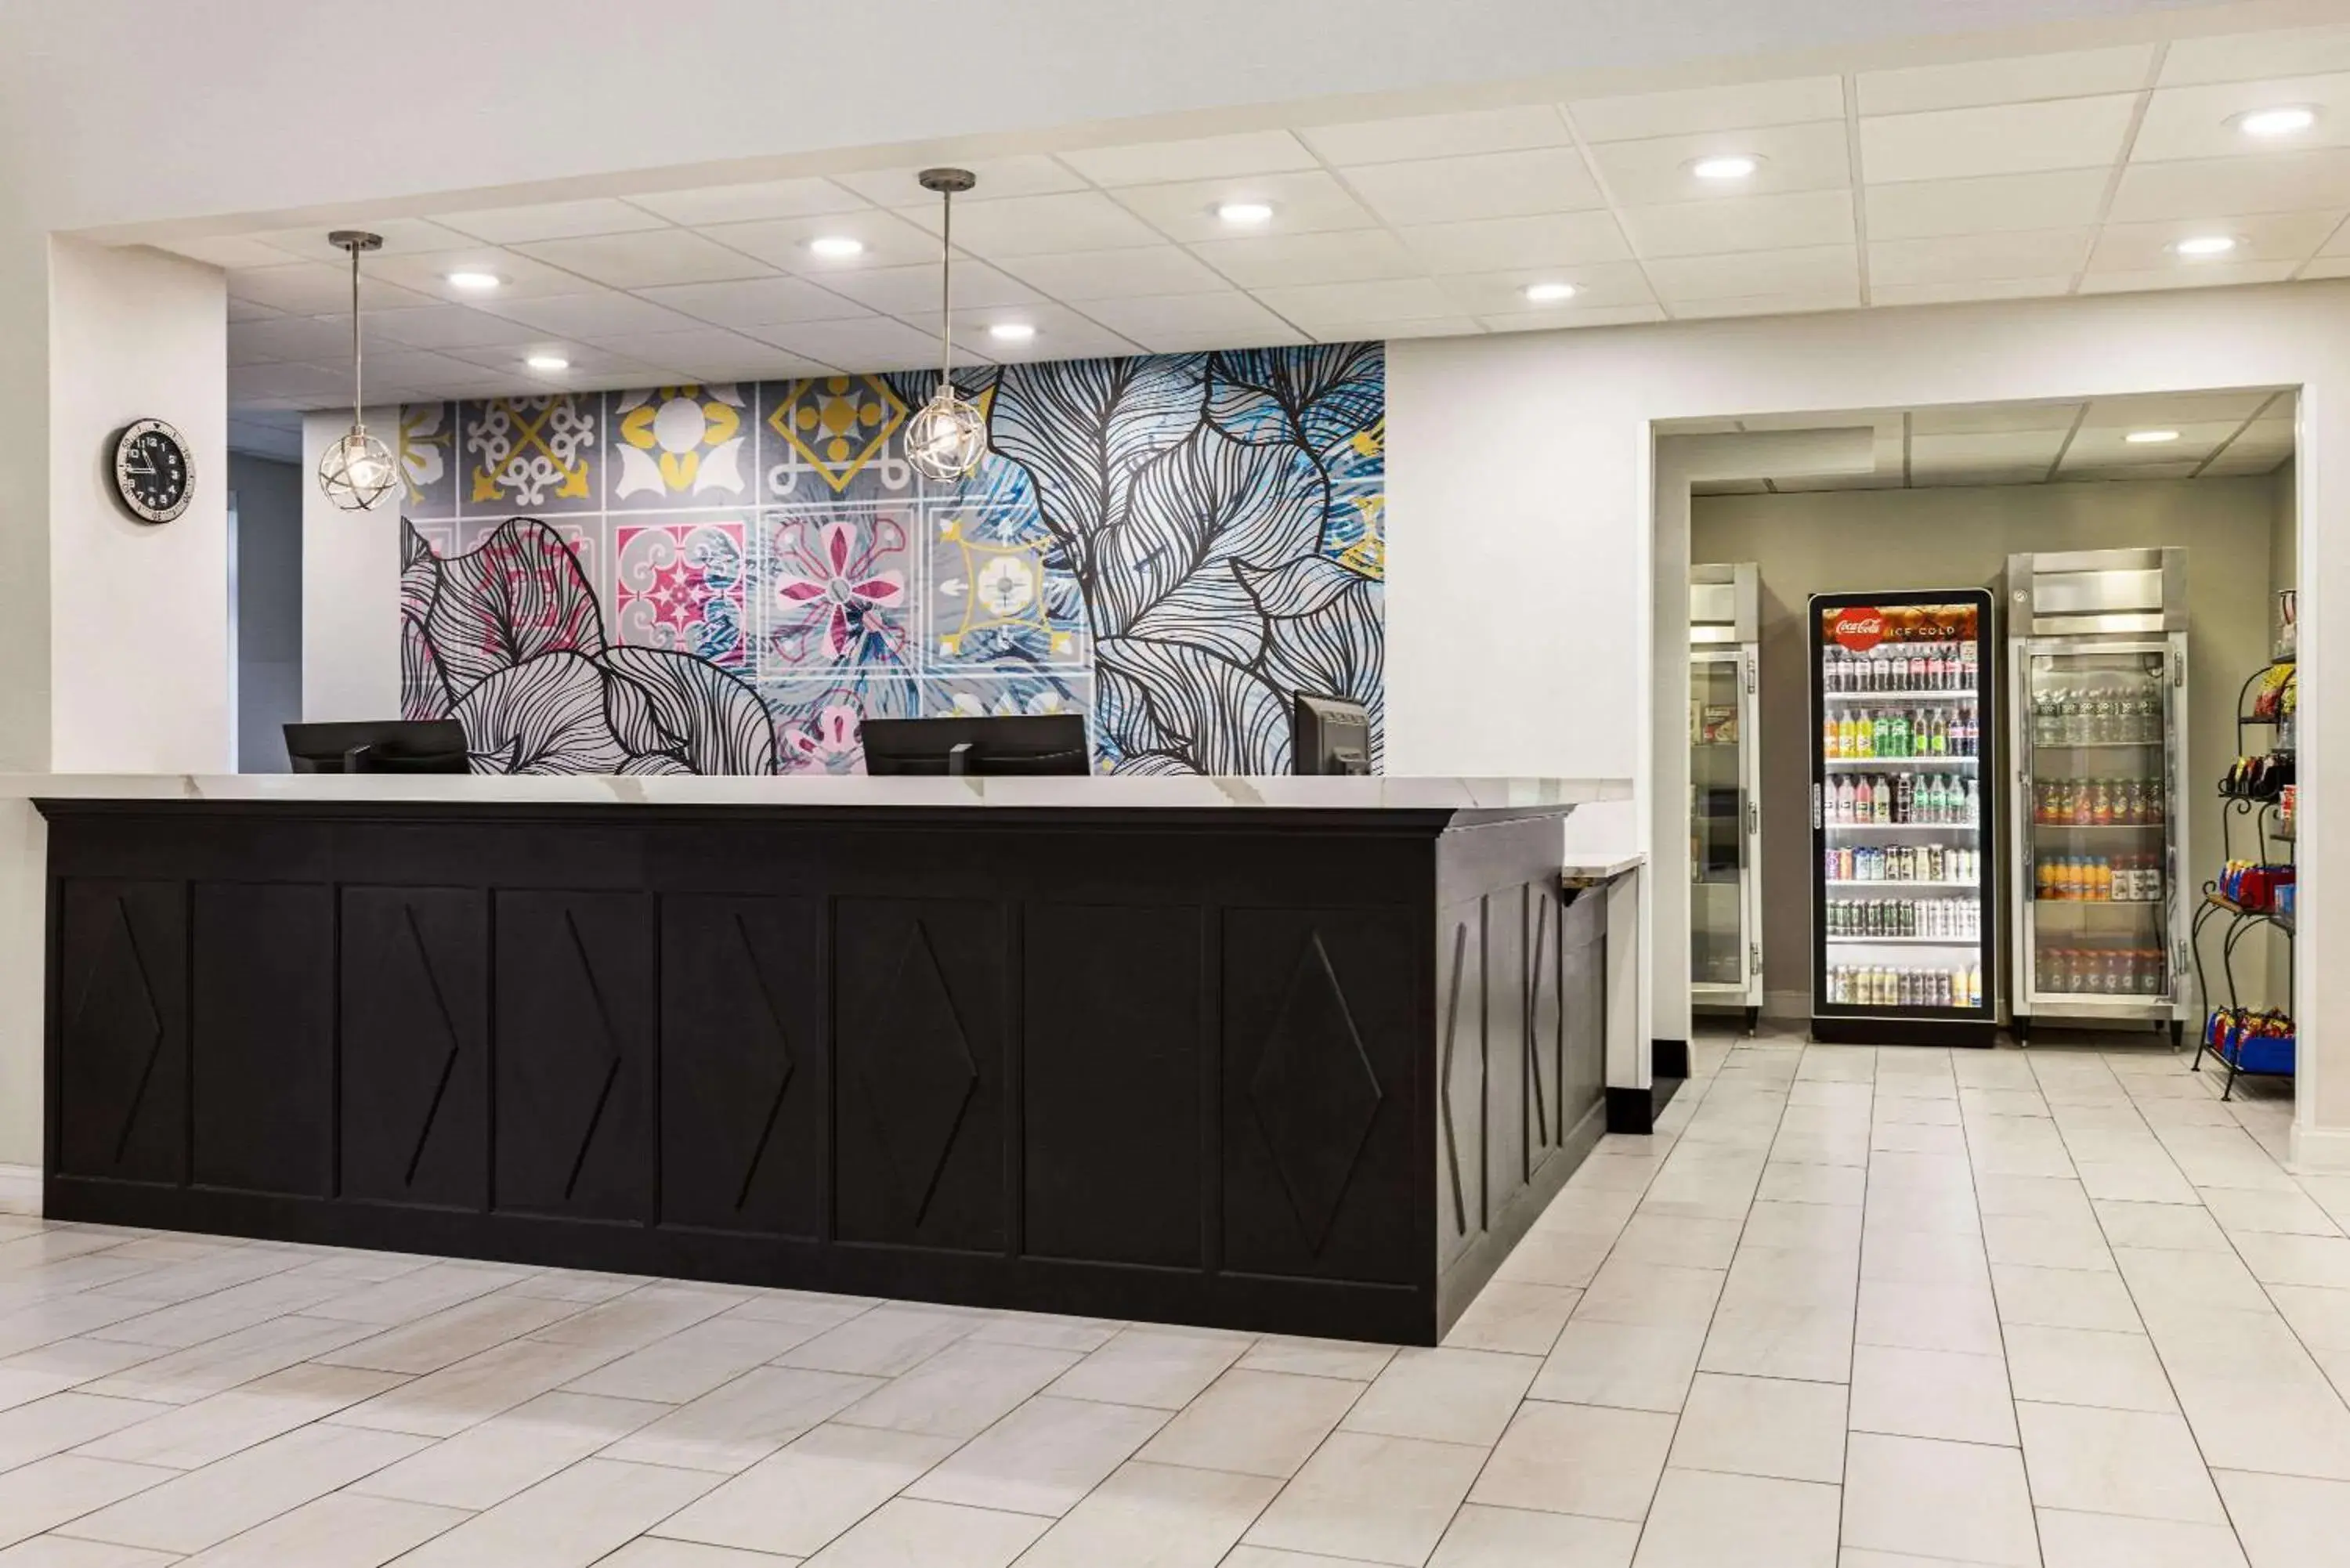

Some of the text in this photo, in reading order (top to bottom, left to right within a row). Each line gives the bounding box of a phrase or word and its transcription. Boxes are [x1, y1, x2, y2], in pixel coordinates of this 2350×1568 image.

[137, 439, 146, 449] 11
[146, 436, 157, 447] 12
[161, 443, 166, 452] 1
[168, 454, 176, 464] 2
[172, 470, 179, 480] 3
[137, 491, 145, 500] 7
[168, 486, 176, 495] 4
[147, 496, 156, 506] 6
[159, 494, 168, 504] 5
[1889, 627, 1955, 637] ICE COLD
